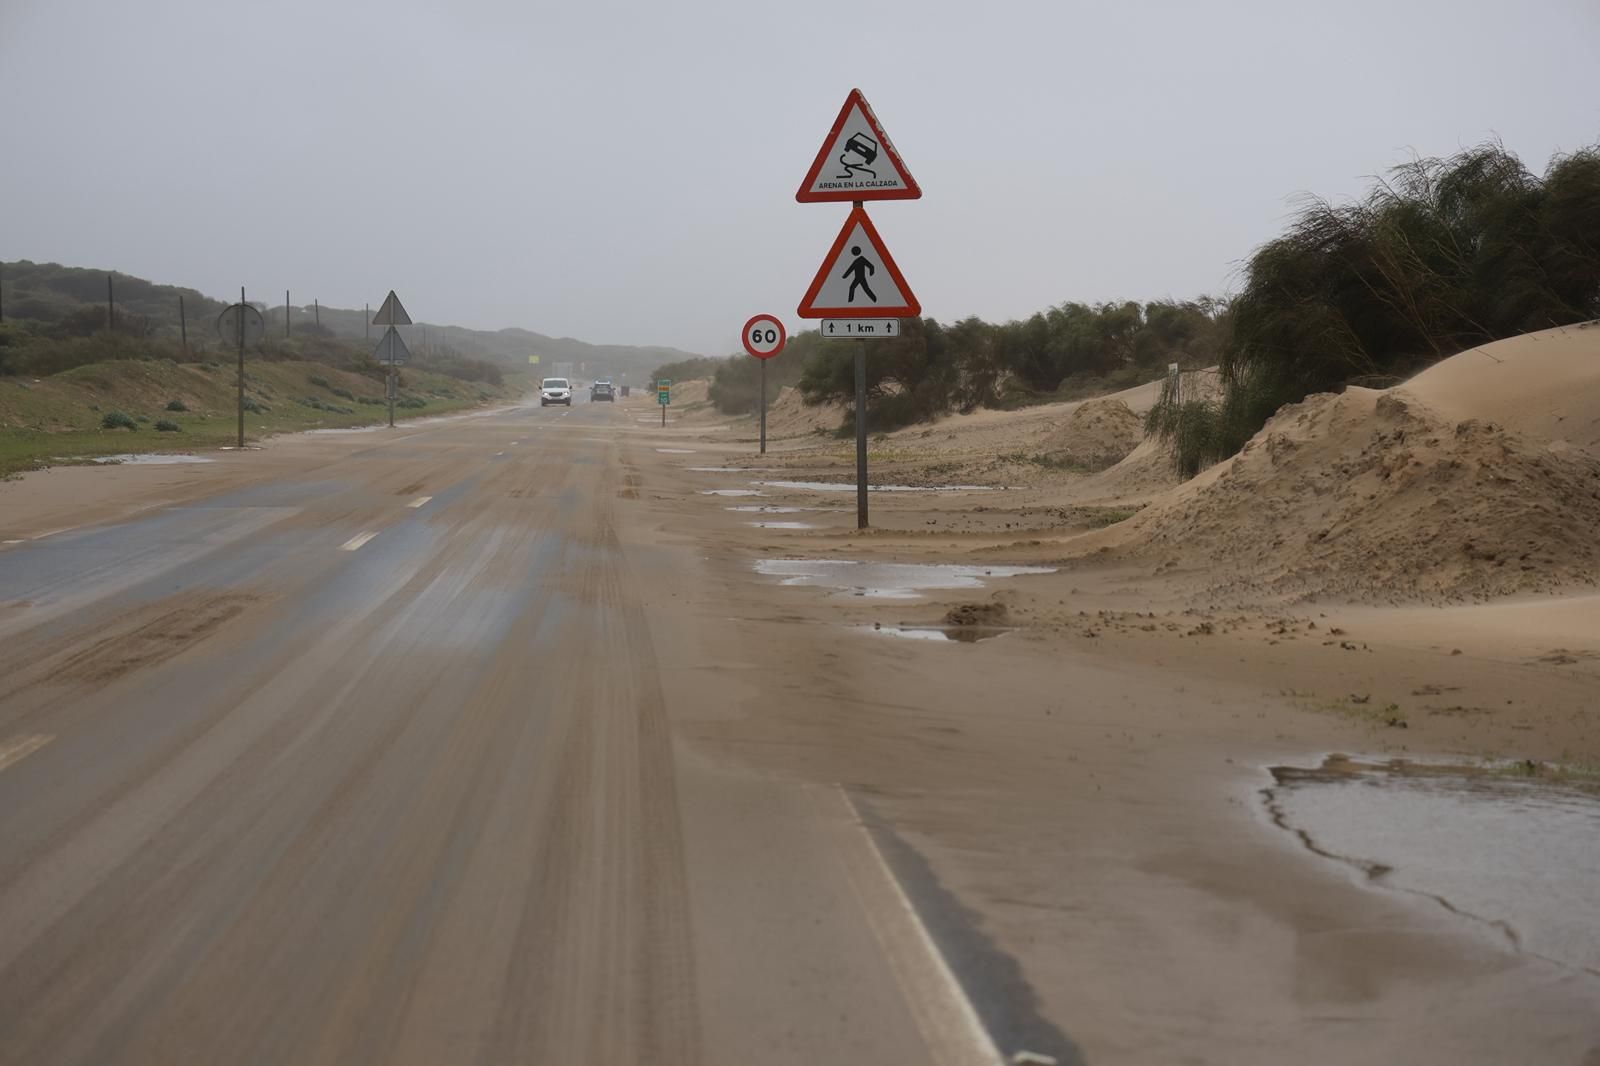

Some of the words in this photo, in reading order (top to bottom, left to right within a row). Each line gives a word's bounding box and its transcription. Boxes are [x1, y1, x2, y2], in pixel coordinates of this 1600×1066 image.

[846, 323, 851, 333] 1
[858, 323, 874, 333] km
[752, 329, 777, 344] 60
